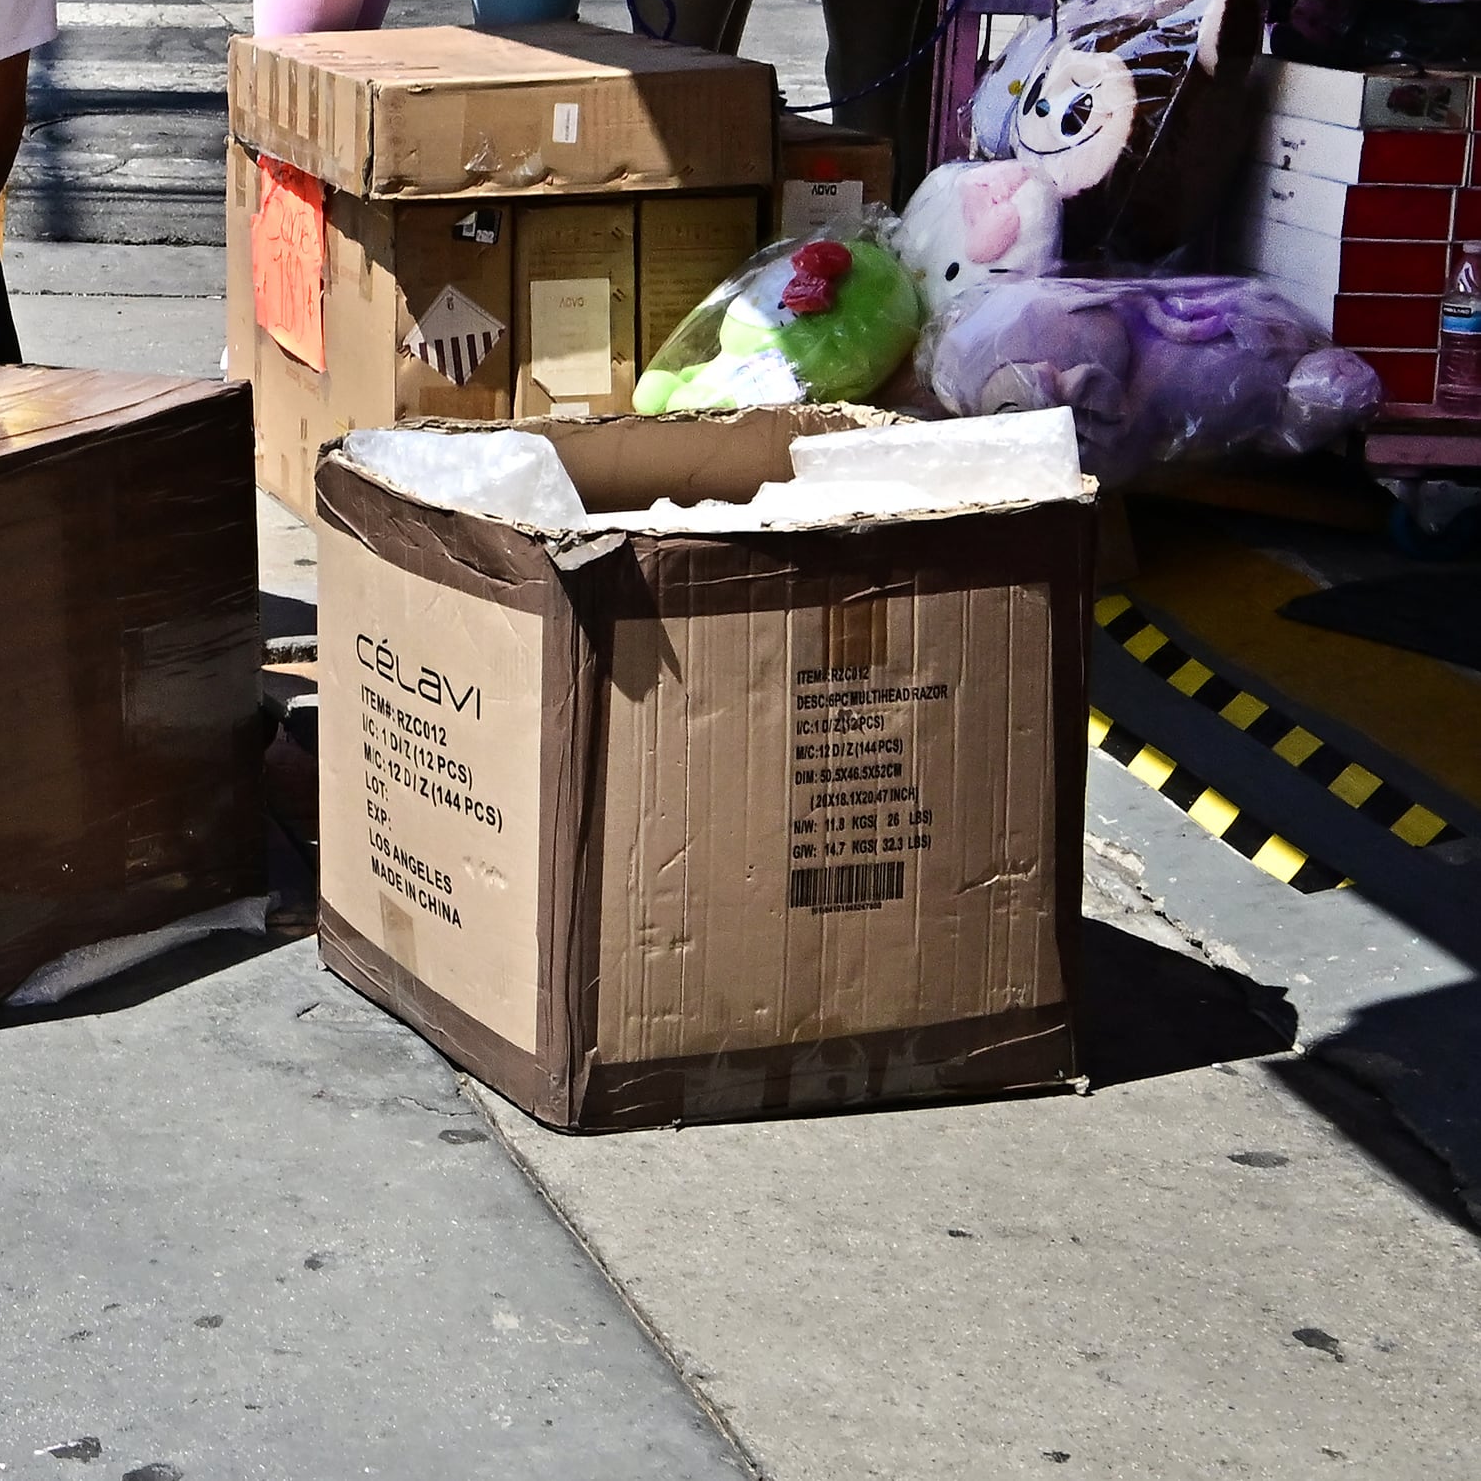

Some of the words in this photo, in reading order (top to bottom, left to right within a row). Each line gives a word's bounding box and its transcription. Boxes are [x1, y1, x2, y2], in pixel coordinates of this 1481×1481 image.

[850, 687, 911, 707] MULTIHEAD
[911, 684, 949, 701] RAZOR
[396, 709, 447, 747] RZC012
[365, 770, 389, 802] LOT:
[437, 754, 473, 792] PCS)
[794, 770, 818, 786] DIM:
[367, 798, 392, 831] EXP:
[464, 796, 503, 834] PCS)
[793, 819, 818, 835] N/W:
[824, 816, 845, 832] 11.8
[887, 812, 900, 827] 26
[909, 809, 933, 826] LBS)
[368, 826, 391, 857] LOS
[393, 844, 453, 895] ANGELES
[792, 843, 817, 860] G/W:
[823, 841, 846, 857] 14.7
[882, 836, 904, 853] 32.3
[907, 834, 932, 850] LBS)
[371, 854, 404, 893] MADE
[404, 878, 417, 903] IN
[418, 889, 463, 929] CHINA
